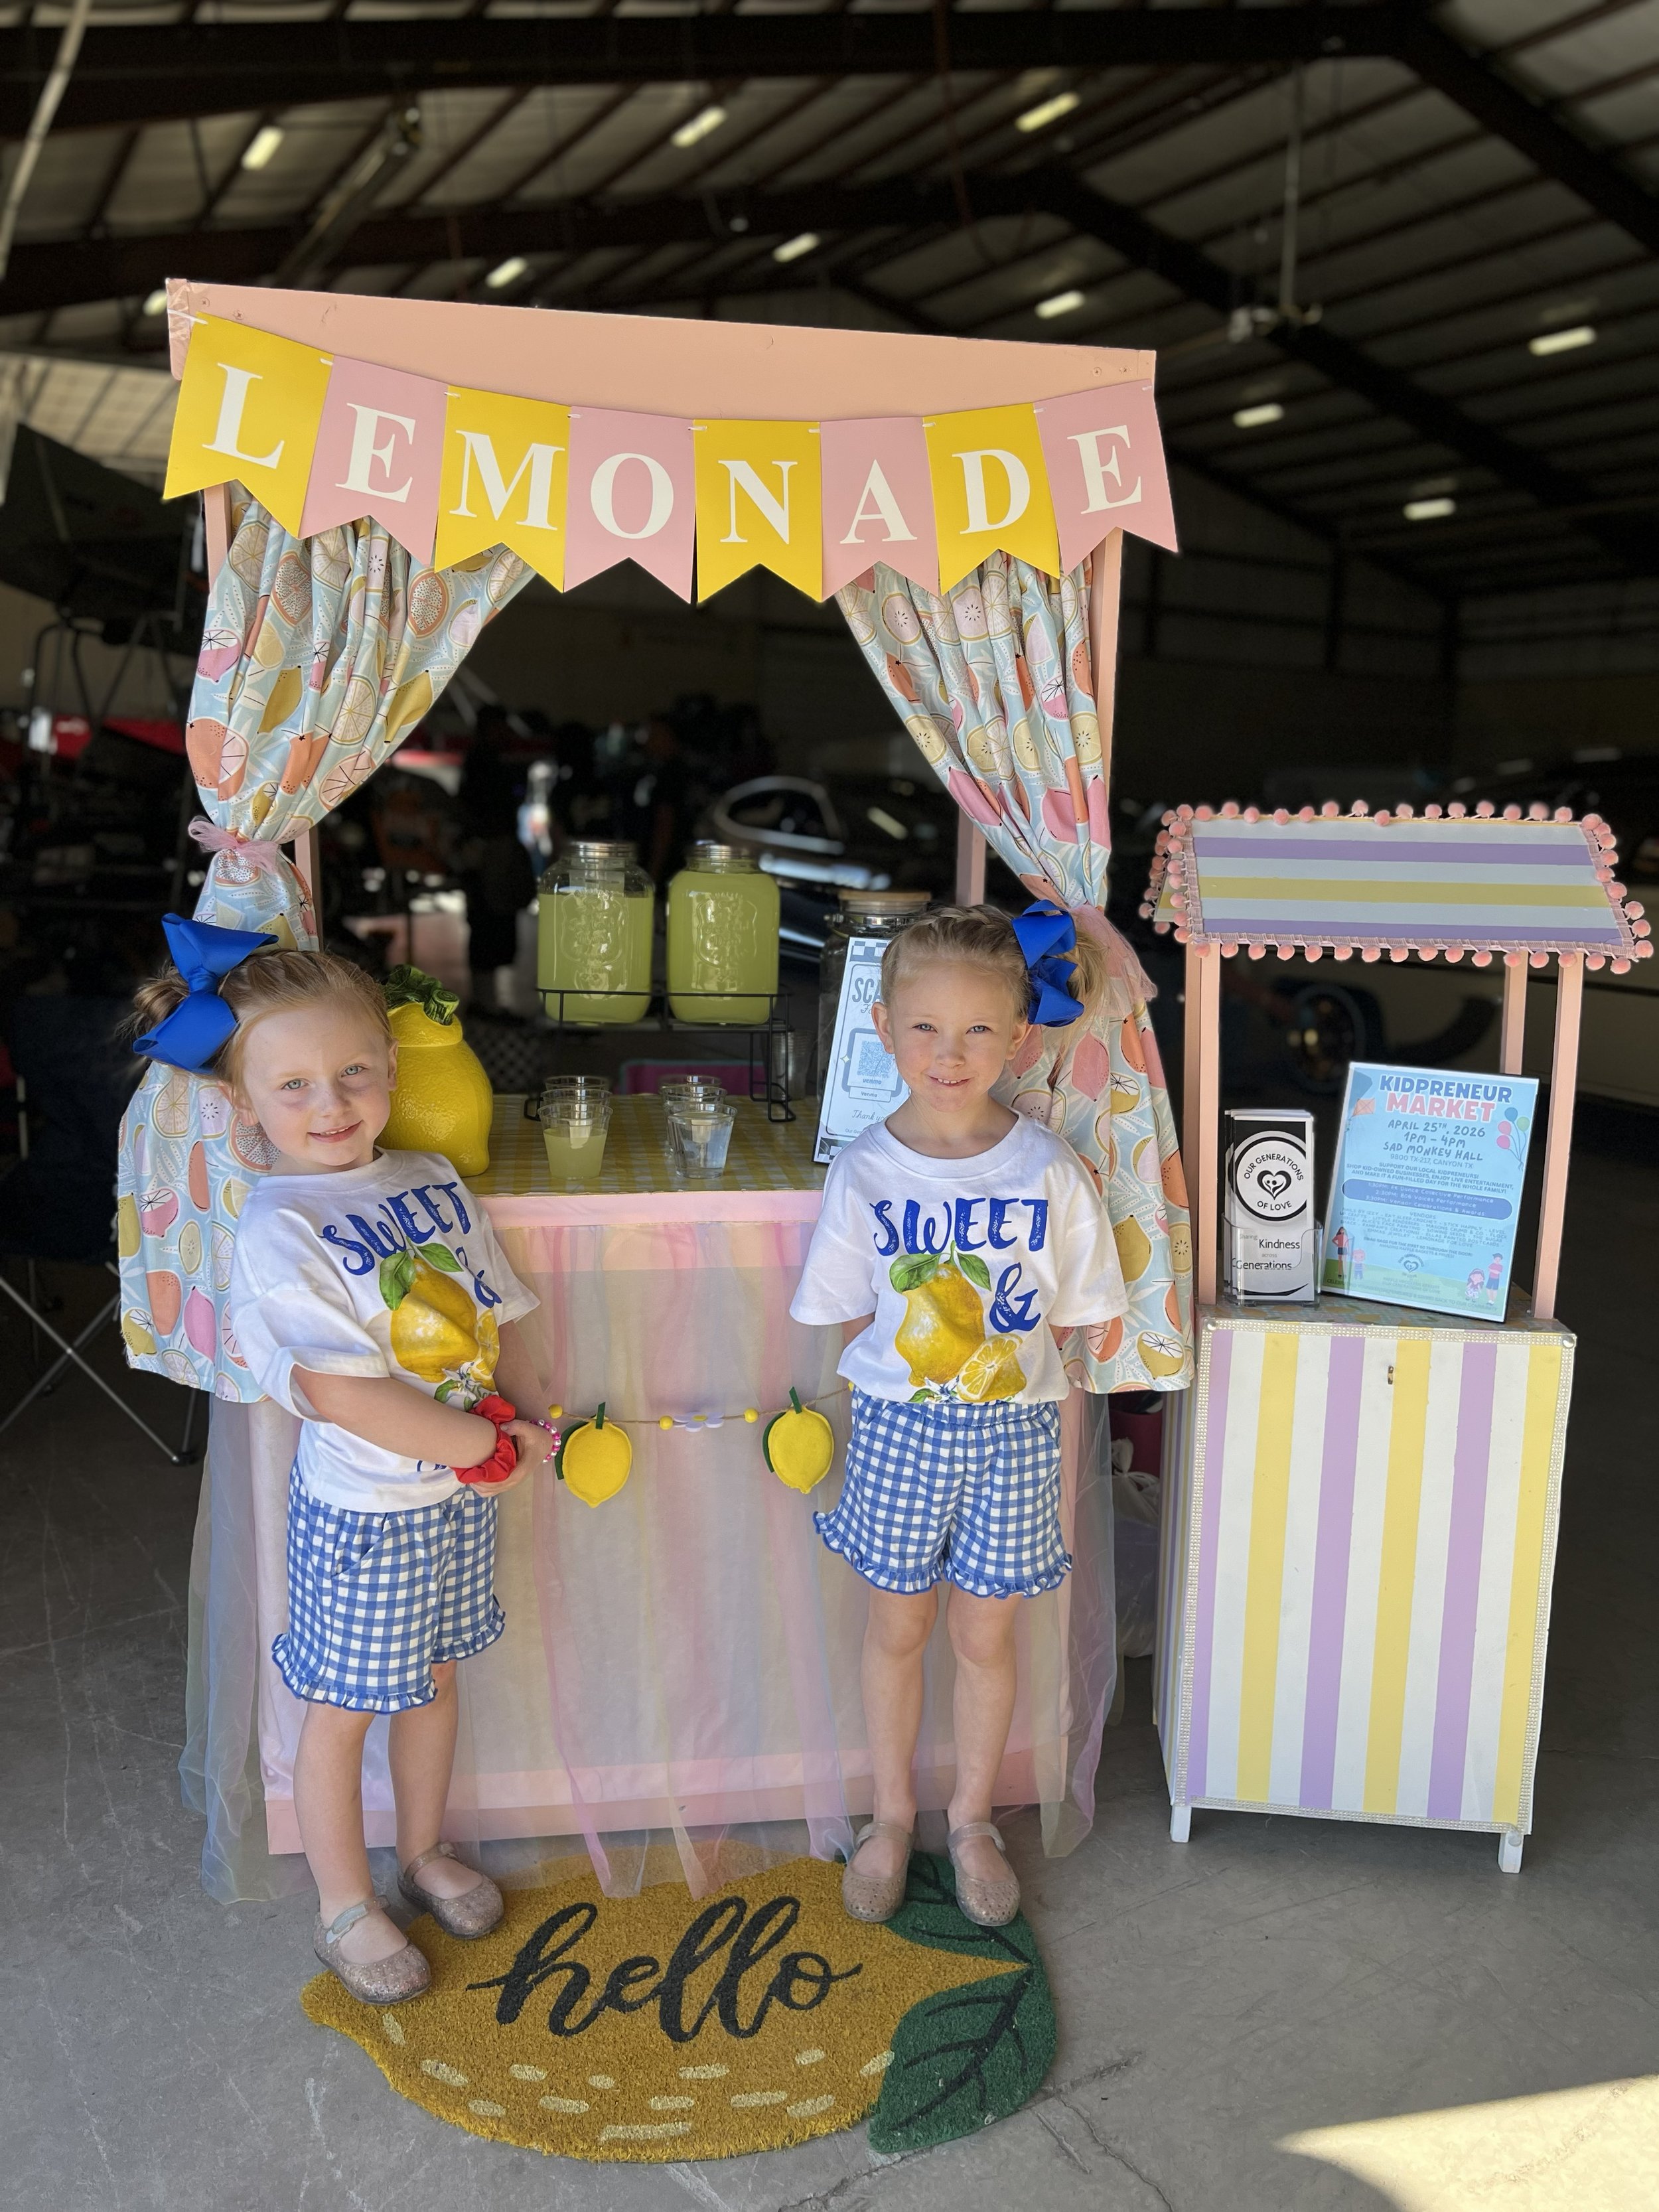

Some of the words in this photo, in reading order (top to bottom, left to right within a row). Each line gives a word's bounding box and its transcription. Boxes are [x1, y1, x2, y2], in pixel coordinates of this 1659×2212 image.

[202, 363, 1142, 546] LEMONADE
[852, 977, 882, 1003] SCA
[1380, 1075, 1512, 1103] KIDPRENEUR
[852, 1110, 876, 1120] Thank
[1386, 1092, 1495, 1122] MARKET
[1388, 1119, 1419, 1131] APRIL
[1453, 1124, 1486, 1138] 2026
[1404, 1131, 1427, 1143] 1PM
[1441, 1135, 1466, 1148] 4PM
[1383, 1141, 1403, 1152] SAD
[1406, 1143, 1451, 1158] MONKEY
[1455, 1149, 1483, 1162] HALL
[1244, 1162, 1257, 1179] OUR
[1255, 1153, 1304, 1181] GENERATIONS
[1433, 1159, 1464, 1167] CANYON
[1396, 1169, 1430, 1178] BUSINESSES,
[1465, 1179, 1514, 1189] ENTERTAINMENT,
[1437, 1169, 1479, 1179] KIDPRENEURS!
[1257, 1200, 1268, 1209] OF
[1270, 1200, 1292, 1211] LOVE
[1413, 1202, 1452, 1212] Celebrations
[1436, 1198, 1476, 1208] Performance
[1453, 1193, 1493, 1203] Performance
[319, 1182, 472, 1276] SWEET
[869, 1198, 1048, 1256] SWEET
[1259, 1239, 1300, 1249] Kindness
[1236, 1260, 1292, 1270] Generations
[455, 1246, 502, 1308] &
[989, 1262, 1041, 1333] &
[466, 1895, 863, 2043] hello
